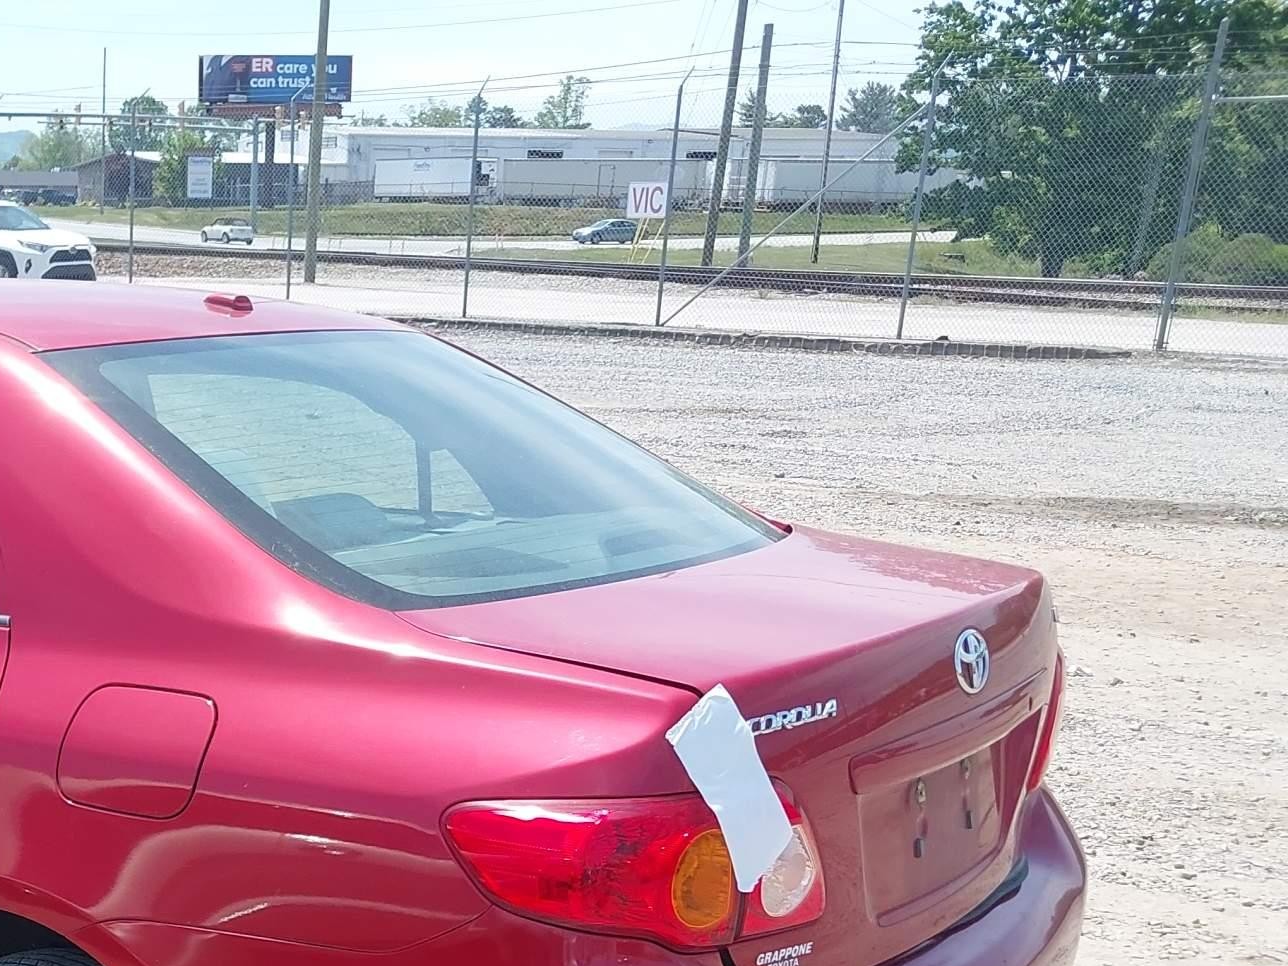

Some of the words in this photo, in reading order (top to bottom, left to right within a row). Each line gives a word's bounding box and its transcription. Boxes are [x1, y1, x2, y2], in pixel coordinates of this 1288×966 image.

[252, 57, 273, 73] ER
[276, 63, 308, 74] care
[249, 77, 276, 88] can
[632, 186, 664, 214] VIC
[745, 698, 837, 736] COROLLA
[756, 941, 814, 966] GRAPPONE
